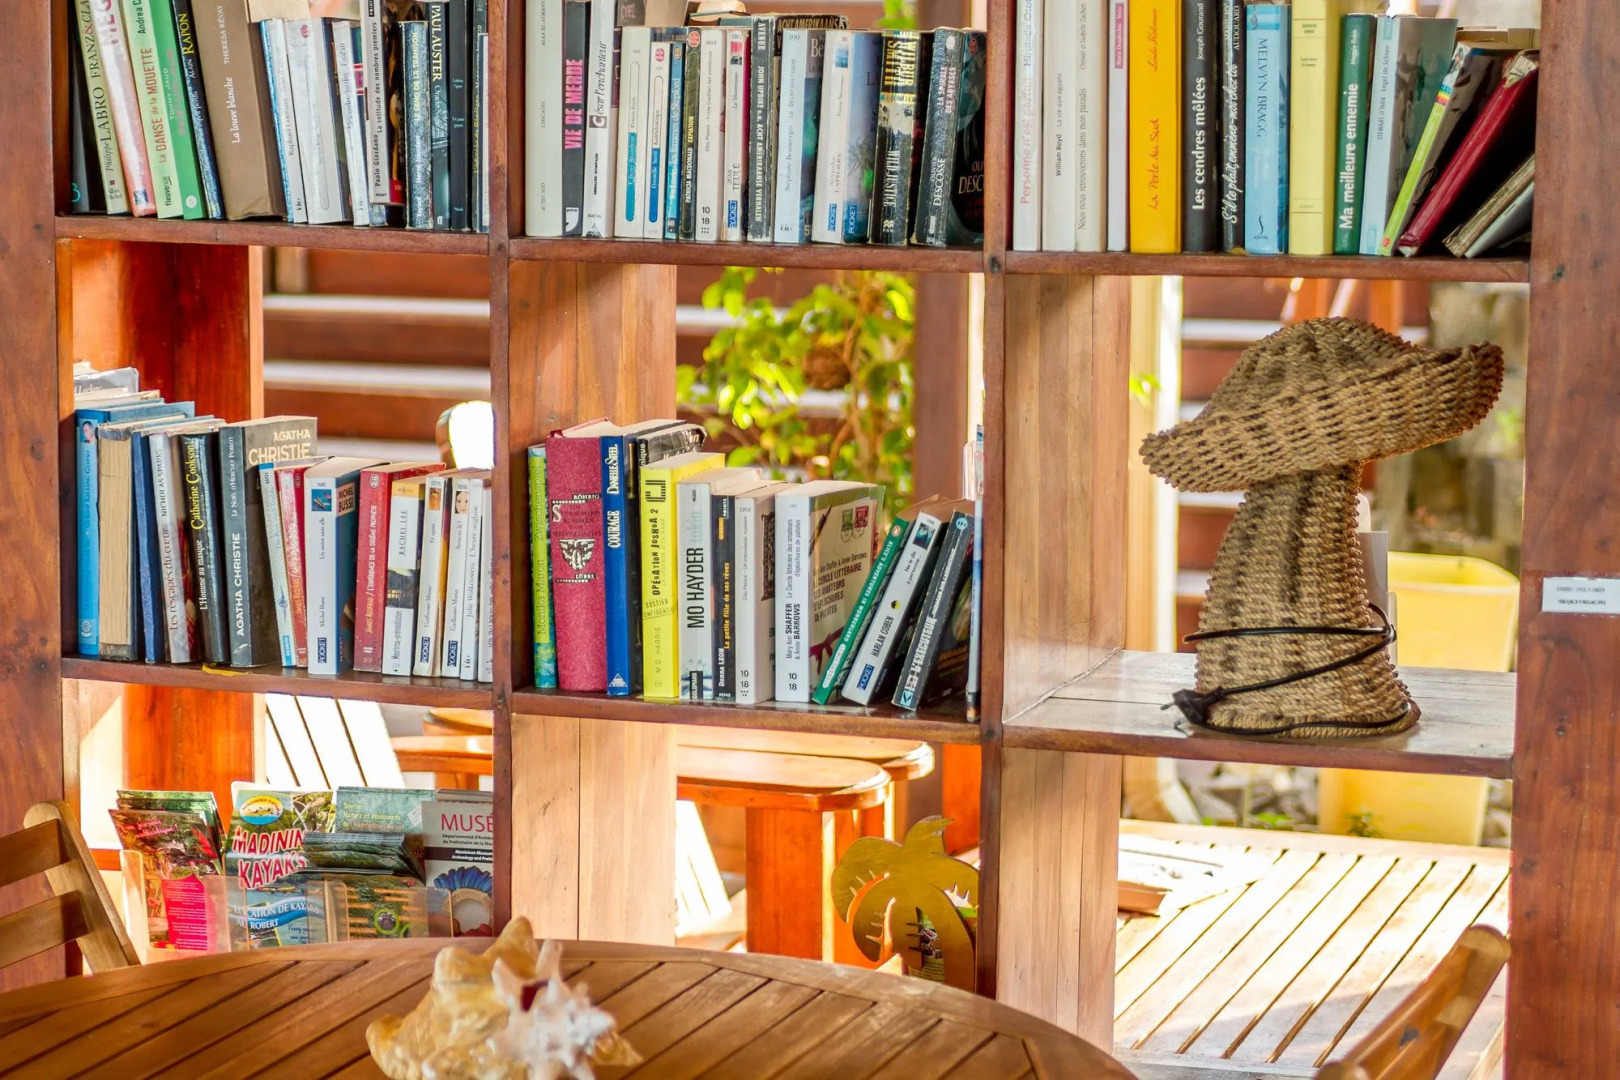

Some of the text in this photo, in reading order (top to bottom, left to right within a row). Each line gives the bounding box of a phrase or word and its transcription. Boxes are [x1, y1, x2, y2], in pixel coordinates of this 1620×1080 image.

[180, 12, 196, 79] ALAIN RAPON
[371, 22, 379, 50] premiers
[431, 5, 443, 82] PAUL AUSTER
[757, 22, 766, 50] AVENUE
[136, 7, 166, 152] DANSE MOUETTE Andrea
[216, 4, 240, 143] La louve blanche THERESA RÉVAY
[884, 41, 902, 86] SMITH
[898, 42, 916, 86] WILBUR
[1257, 38, 1268, 91] MELVYN
[672, 78, 681, 110] Stepford
[756, 85, 765, 108] UPDIKE
[937, 66, 948, 106] LA SPIRALE
[945, 67, 956, 113] DES ABYSSES
[1078, 88, 1088, 112] paradis
[1224, 80, 1238, 100] chez
[92, 86, 112, 141] LABRO
[565, 60, 582, 149] VIE DE MERDE
[1192, 4, 1206, 210] Les cendres mêlées Joseph Gourand
[1256, 95, 1268, 137] BRAGG
[377, 125, 382, 133] La
[1056, 119, 1062, 128] La
[1376, 117, 1384, 140] STEWART
[756, 142, 764, 187] AMERIKAANSE
[1148, 118, 1159, 210] La Perle du Sud
[1338, 84, 1358, 229] Ma meilleure ennemie
[882, 150, 900, 208] WILD JUSTICE
[933, 158, 946, 206] DESCOSSE
[1020, 150, 1032, 204] Personne
[755, 188, 764, 222] VERHALEN
[848, 206, 856, 234] POCKET
[1078, 212, 1086, 230] Nous
[273, 429, 311, 442] AGATHA
[248, 442, 311, 466] CHRISTIE
[155, 449, 178, 630] Les rescapés du NICHOLAS SPARKS
[186, 445, 208, 610] L'Homme au masque Catherine Cookson
[398, 526, 406, 556] RACHEL
[607, 510, 621, 548] COURAGE
[650, 518, 660, 548] JOSHUA
[532, 465, 546, 635] Monika Maron Zwischenspiel
[794, 546, 802, 578] d'épluchures
[882, 540, 894, 562] ALICE'S
[232, 533, 245, 636] AGATHA CHRISTIE
[650, 552, 661, 596] OPÉRATION
[834, 562, 862, 580] LITTÉRAIRE
[866, 562, 884, 597] ADVENTURES
[686, 548, 705, 628] MO HAYDER
[724, 594, 730, 602] de
[366, 618, 374, 634] JAMES
[723, 620, 731, 640] petite
[785, 604, 793, 634] SHAFFER
[844, 605, 863, 642] WONDERLAND
[318, 638, 326, 664] POCKET
[420, 636, 430, 663] POCKET
[724, 641, 730, 649] La
[786, 646, 794, 659] Mary
[870, 615, 894, 658] HARLAN COBEN
[448, 640, 456, 667] POCKET
[740, 670, 749, 678] 10
[856, 664, 874, 690] POCKET
[238, 852, 307, 888] KAYAKS
[278, 902, 289, 912] DE
[250, 918, 279, 930] ROBERT
